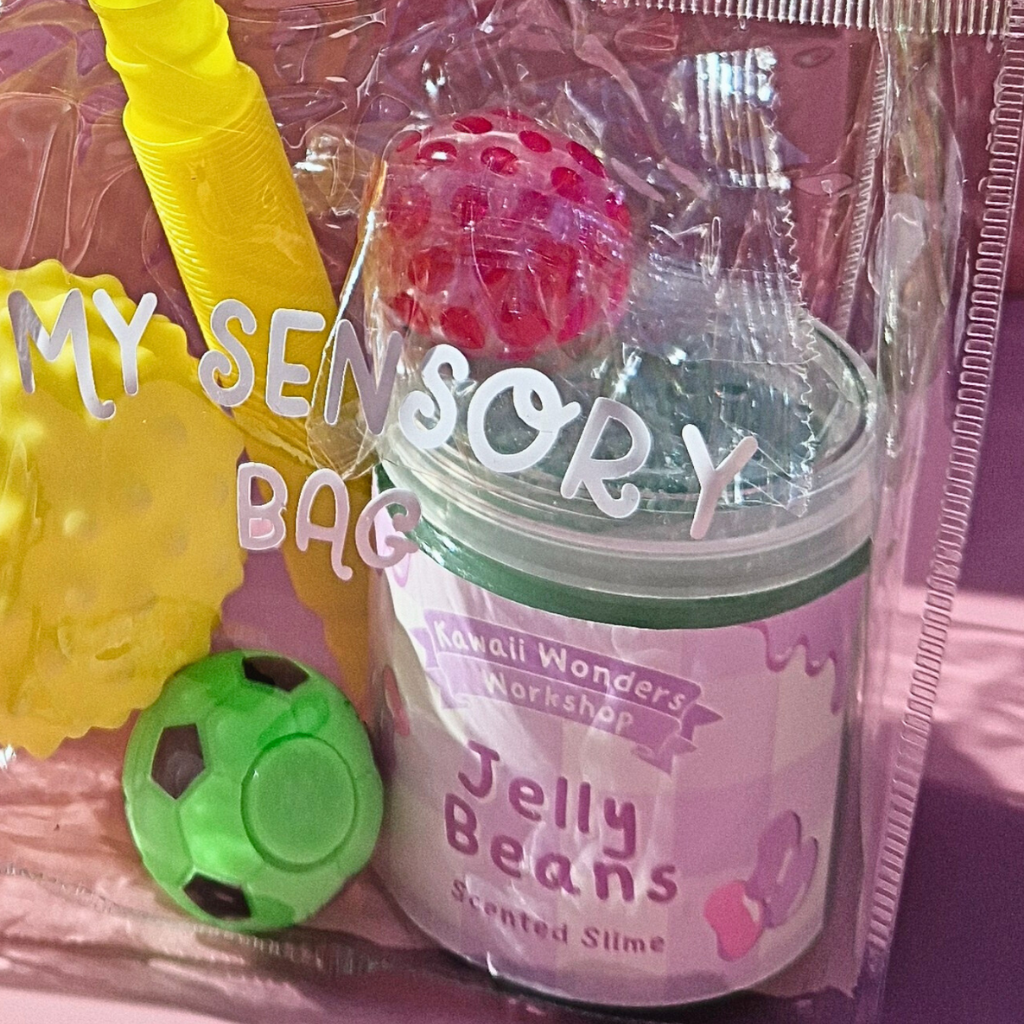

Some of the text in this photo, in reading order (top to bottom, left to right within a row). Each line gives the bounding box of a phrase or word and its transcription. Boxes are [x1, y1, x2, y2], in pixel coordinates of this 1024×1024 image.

[7, 289, 759, 540] MY SENSORY
[237, 463, 422, 582] BAG
[434, 619, 686, 711] Kawaii Wonders
[483, 670, 634, 735] Workshop
[444, 793, 679, 903] Beans
[457, 739, 636, 860] Jelly
[451, 878, 666, 954] Scented Slime
